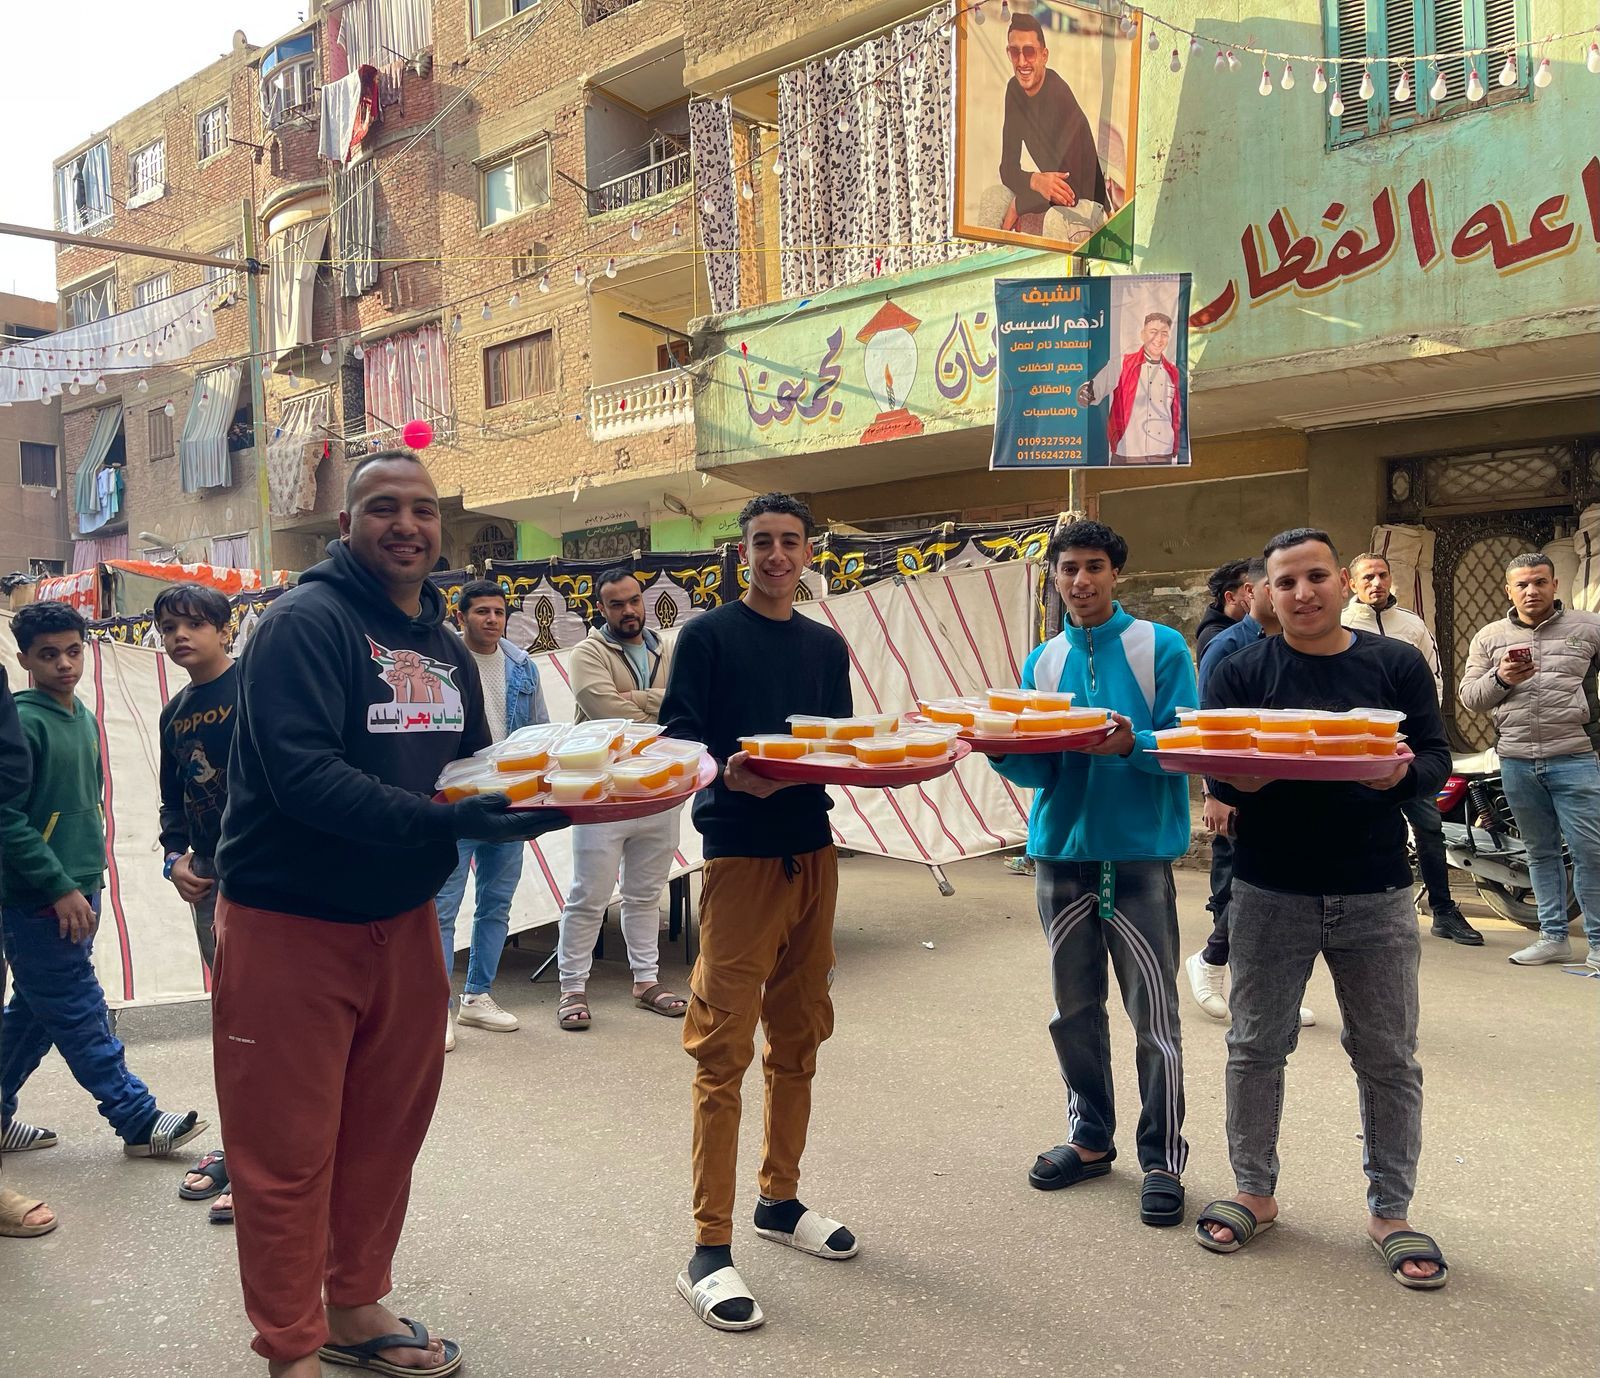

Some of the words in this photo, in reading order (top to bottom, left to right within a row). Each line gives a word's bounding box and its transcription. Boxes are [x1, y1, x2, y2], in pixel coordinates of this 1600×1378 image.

[1188, 178, 1446, 333] الفطار
[1022, 284, 1081, 306] الشيف
[1064, 310, 1105, 335] أدهم
[1010, 341, 1034, 352] لعمل
[1036, 340, 1053, 351] تام
[1018, 362, 1054, 372] الحفلات
[1056, 363, 1083, 374] جميع
[1029, 385, 1072, 396] والعقائق
[1023, 407, 1078, 418] والمناسبات
[1017, 436, 1082, 447] 01093275924
[1017, 450, 1082, 460] 01156242782
[370, 707, 403, 730] البلد
[404, 711, 431, 729] بحر
[432, 706, 463, 729] شباب
[1102, 860, 1111, 910] CKET
